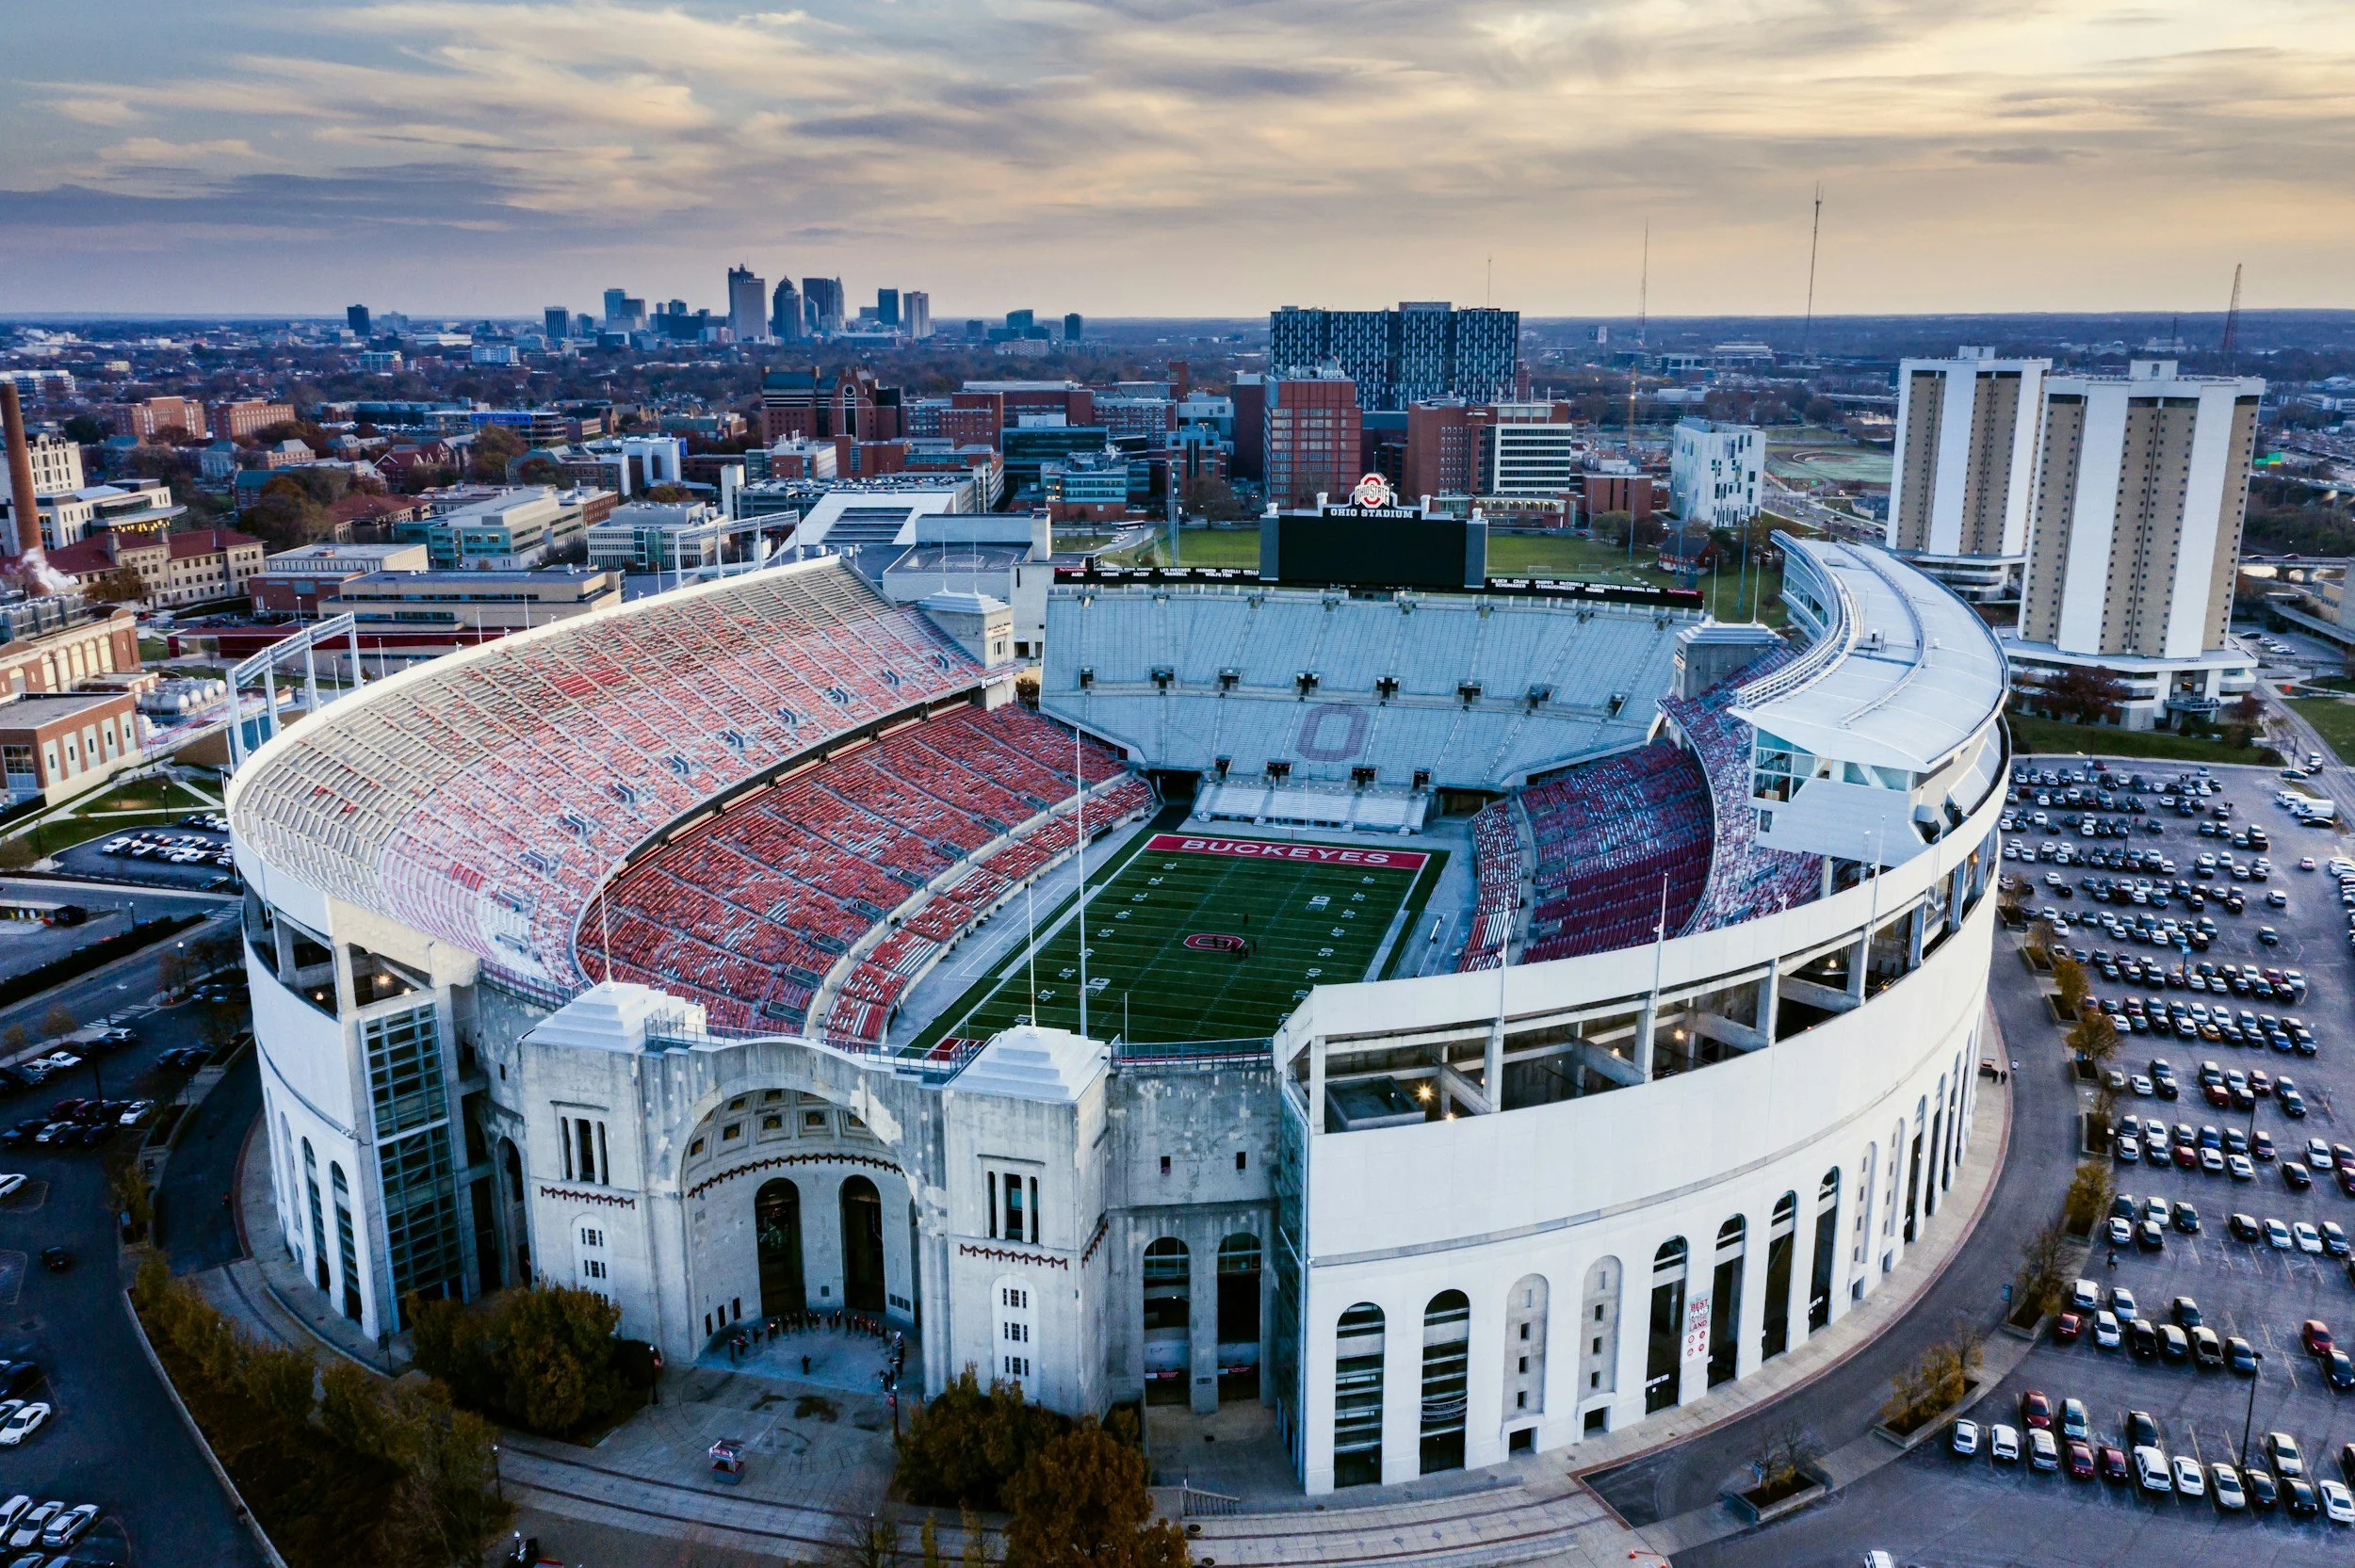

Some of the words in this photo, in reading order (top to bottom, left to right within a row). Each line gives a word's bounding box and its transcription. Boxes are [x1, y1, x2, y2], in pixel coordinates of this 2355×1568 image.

[1330, 508, 1357, 517] OHIO
[1360, 509, 1414, 519] STADIUM
[1181, 839, 1390, 864] BUCKEYES
[1097, 929, 1115, 938] 50
[1318, 947, 1334, 957] 50
[1059, 968, 1076, 978] 30
[1307, 967, 1323, 978] 40
[1037, 990, 1056, 999] 20
[1690, 1298, 1709, 1312] BEST
[1689, 1307, 1709, 1319] FANS
[1688, 1319, 1708, 1332] LAND
